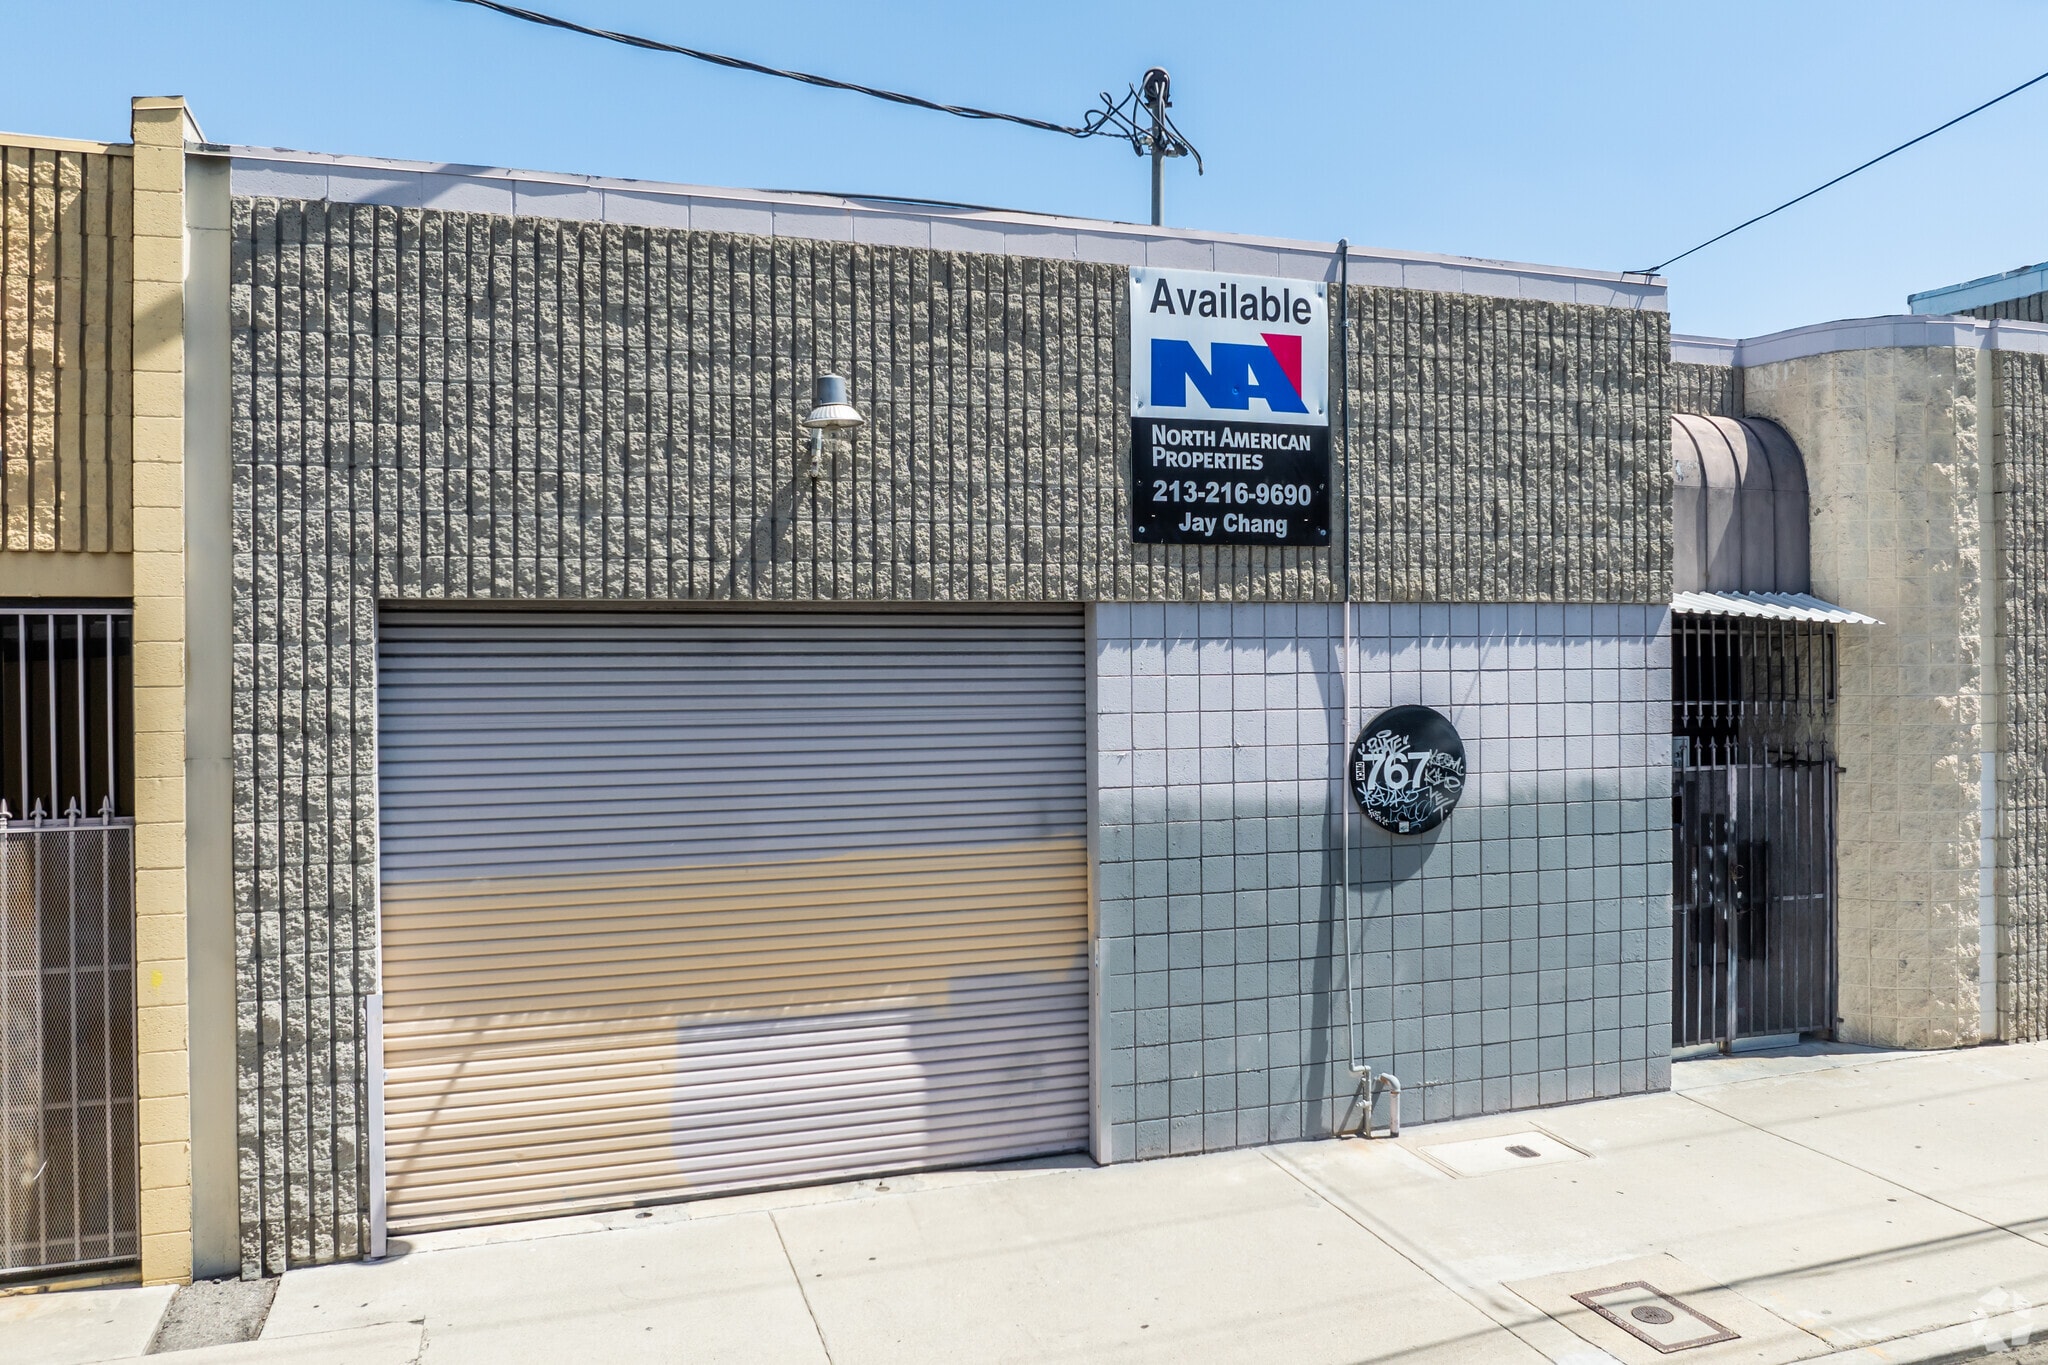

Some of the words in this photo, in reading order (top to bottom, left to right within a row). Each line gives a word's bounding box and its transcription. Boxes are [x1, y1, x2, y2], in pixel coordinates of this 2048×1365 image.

[1149, 278, 1312, 325] Available
[1151, 424, 1216, 447] NORTH
[1219, 427, 1312, 451] AMERICAN
[1152, 446, 1264, 471] PROPERTIES
[1152, 480, 1312, 506] 213-216-9690
[1178, 512, 1217, 537] Jay
[1223, 513, 1288, 538] Chang
[1362, 751, 1431, 791] 767
